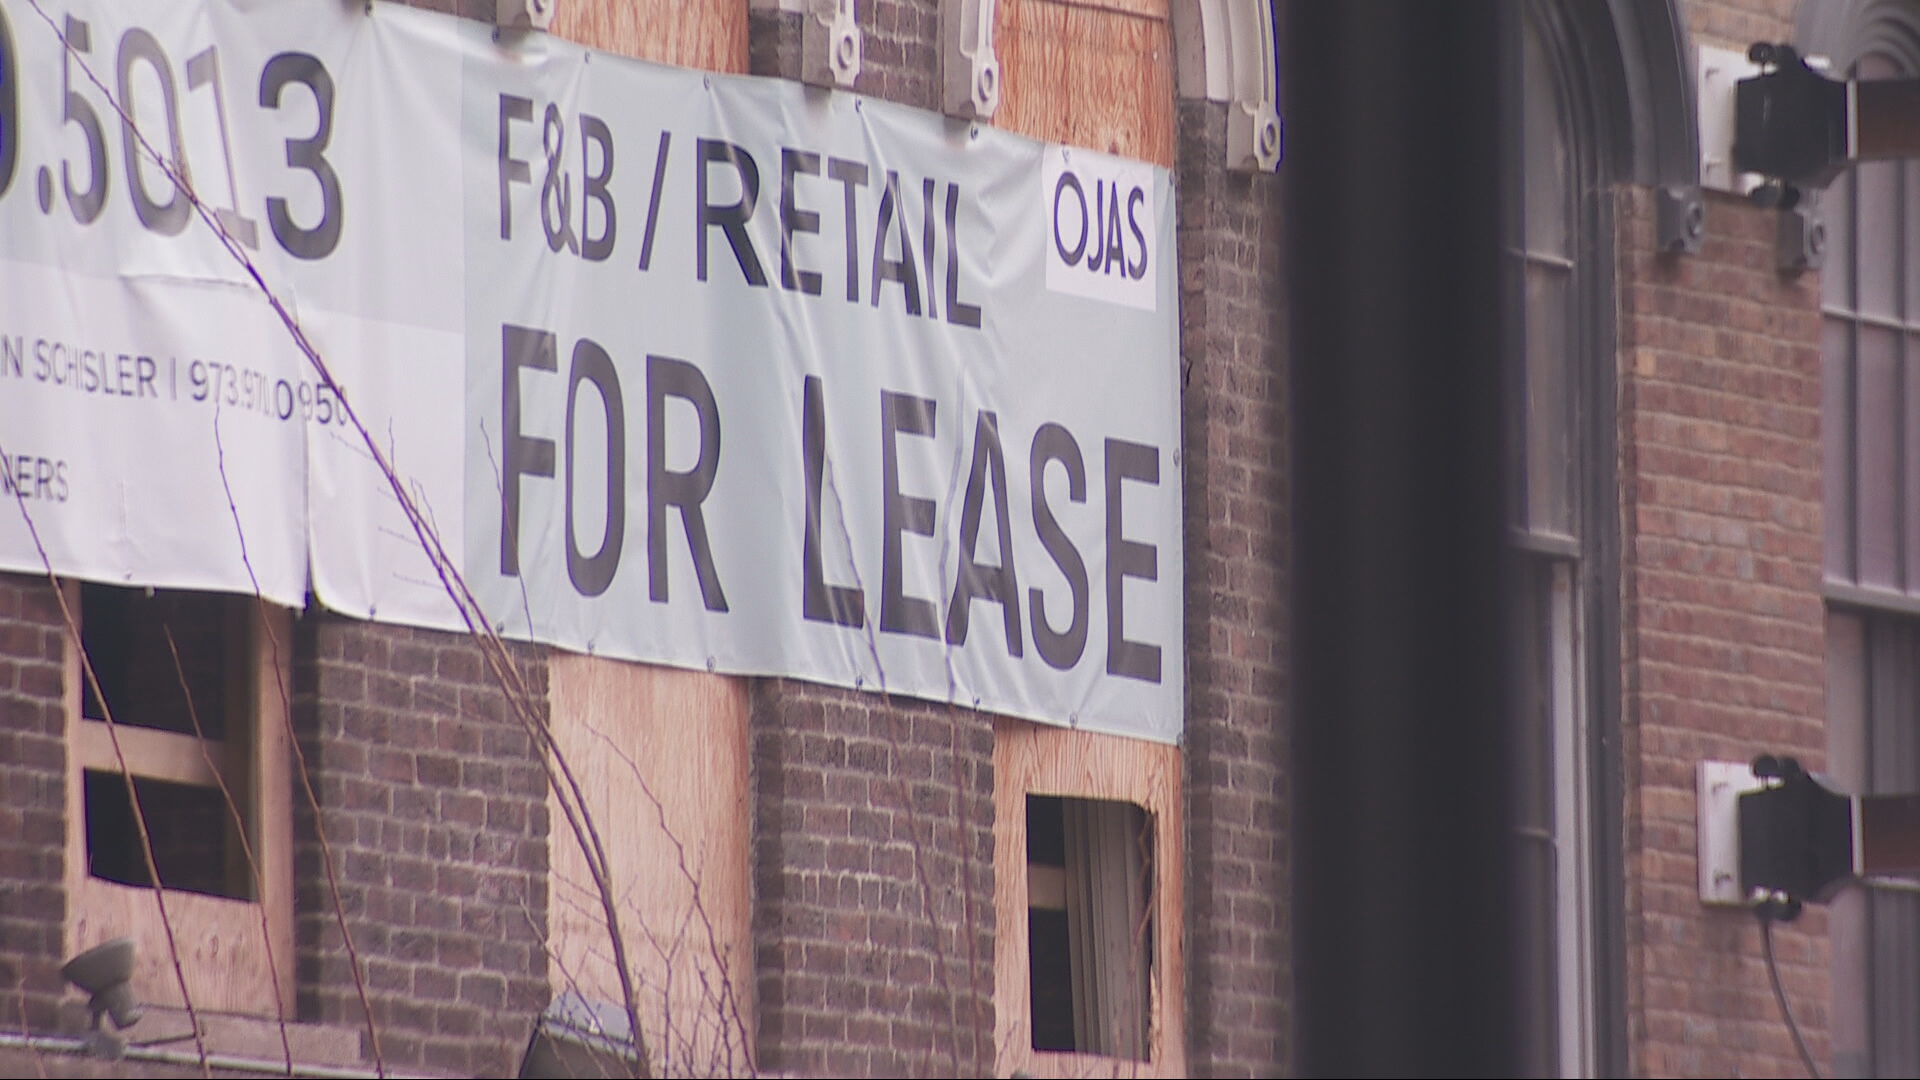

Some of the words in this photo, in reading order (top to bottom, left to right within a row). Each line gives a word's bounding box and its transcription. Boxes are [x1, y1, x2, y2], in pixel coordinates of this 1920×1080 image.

[499, 93, 617, 262] F&B
[696, 137, 982, 330] RETAIL
[1053, 171, 1148, 281] OJAS
[33, 338, 158, 398] SCHISLER
[500, 323, 730, 614] FOR
[802, 373, 1162, 684] LEASE
